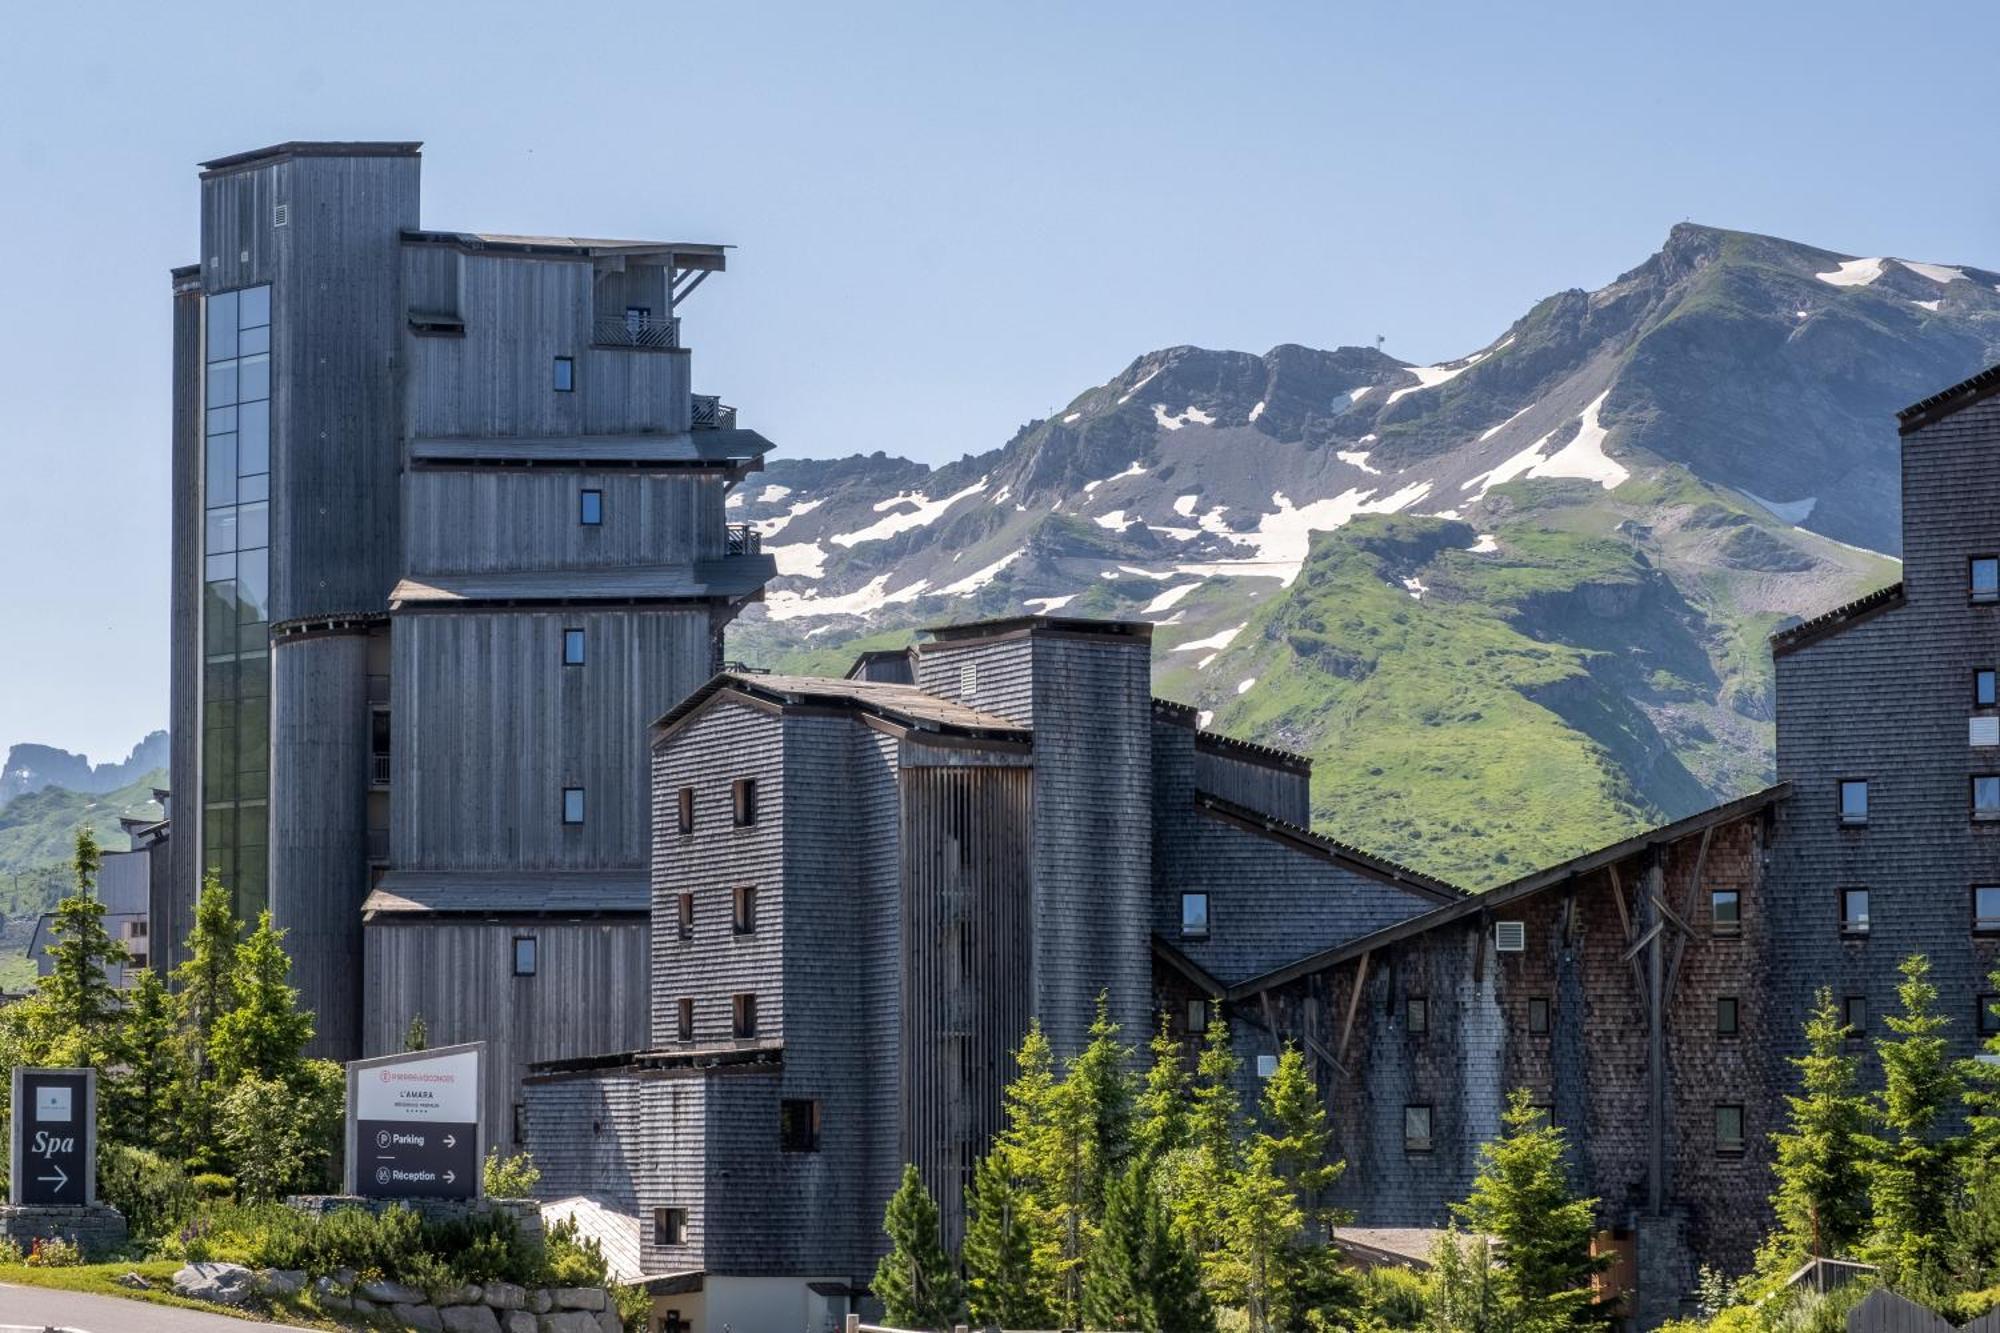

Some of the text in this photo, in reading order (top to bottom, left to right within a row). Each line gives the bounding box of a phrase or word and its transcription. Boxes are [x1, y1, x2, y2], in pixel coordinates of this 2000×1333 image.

[32, 1131, 74, 1159] Spa
[393, 1134, 424, 1146] Parking
[393, 1169, 435, 1182] Réception
